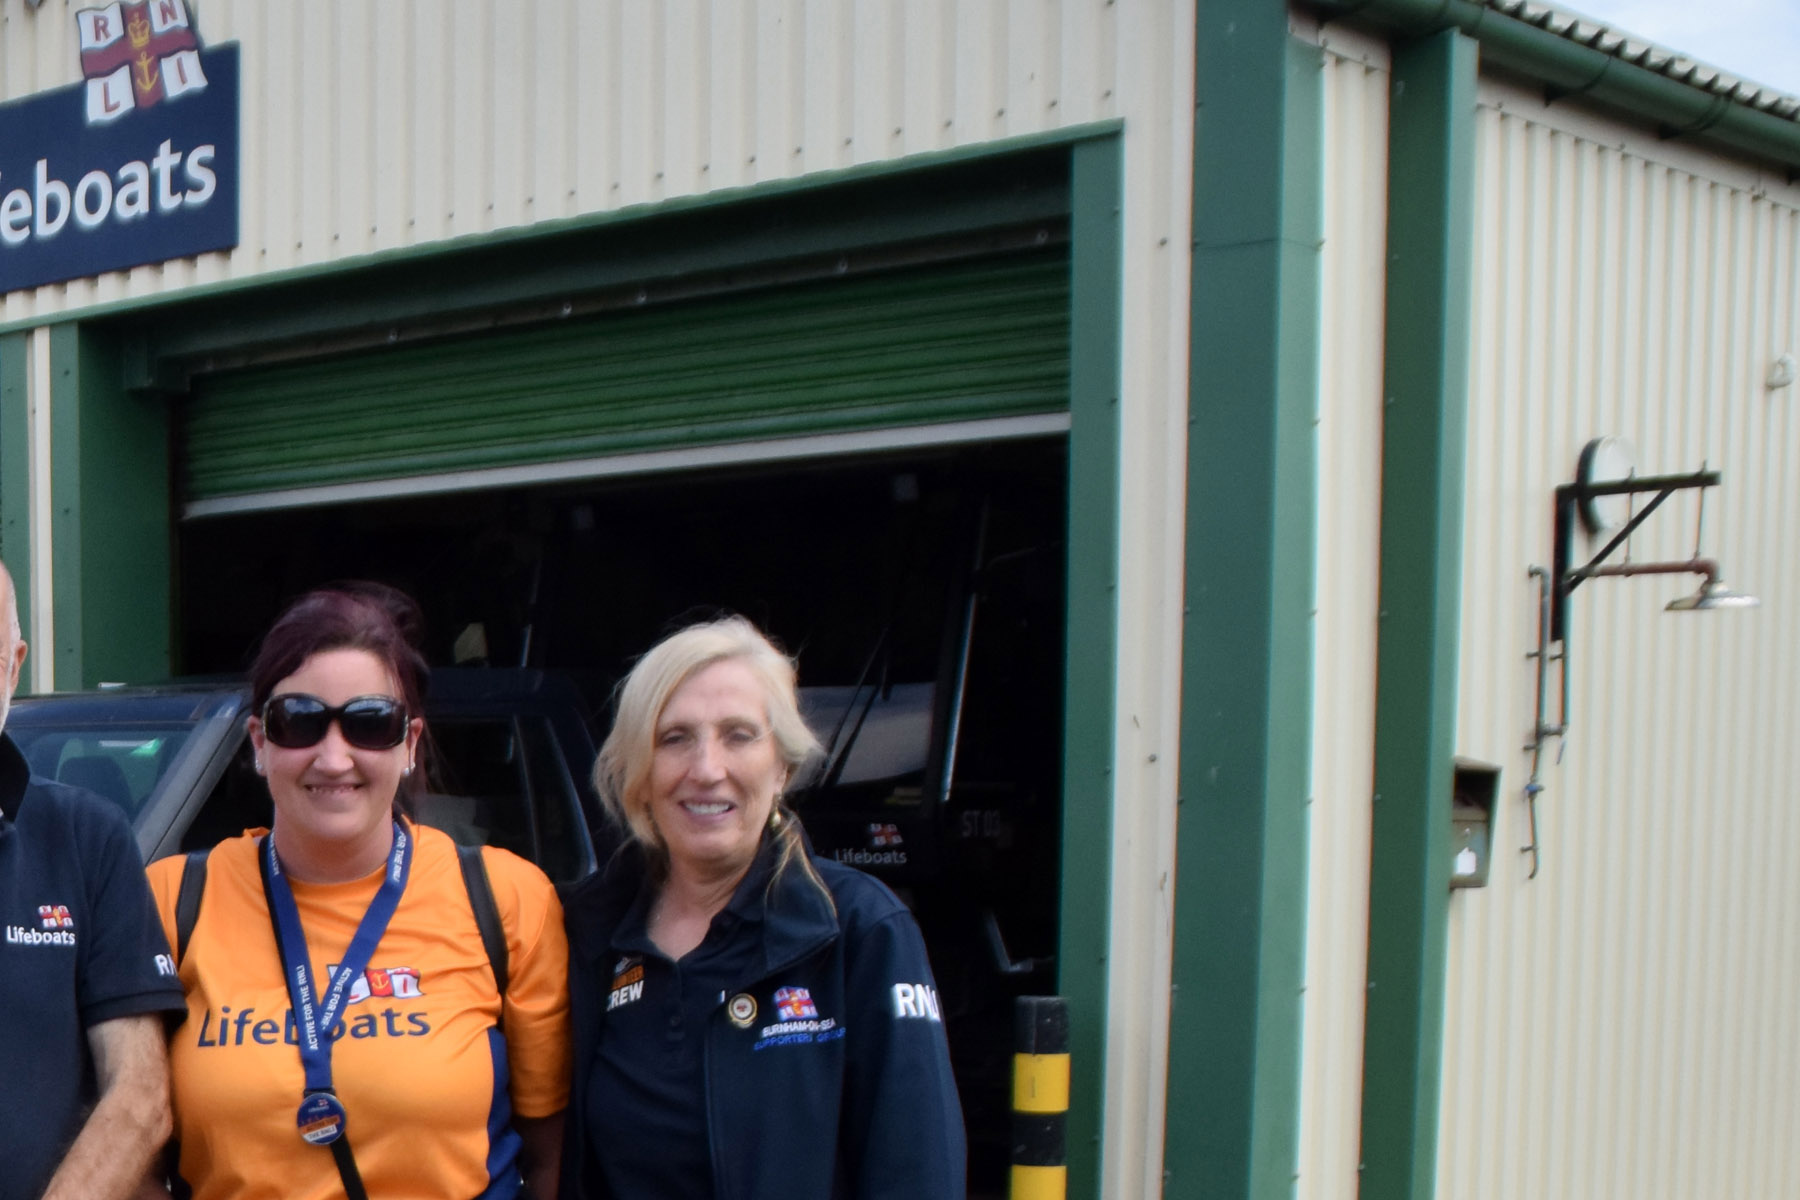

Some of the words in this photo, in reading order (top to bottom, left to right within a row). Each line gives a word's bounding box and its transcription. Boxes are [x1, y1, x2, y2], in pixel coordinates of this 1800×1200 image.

[835, 847, 908, 865] Lifeboats
[6, 925, 76, 946] Lifeboats
[296, 964, 307, 985] RNLI
[300, 985, 310, 1003] THE
[327, 993, 341, 1012] FOR
[303, 1003, 314, 1020] FOR
[306, 1020, 318, 1050] ACTIVE
